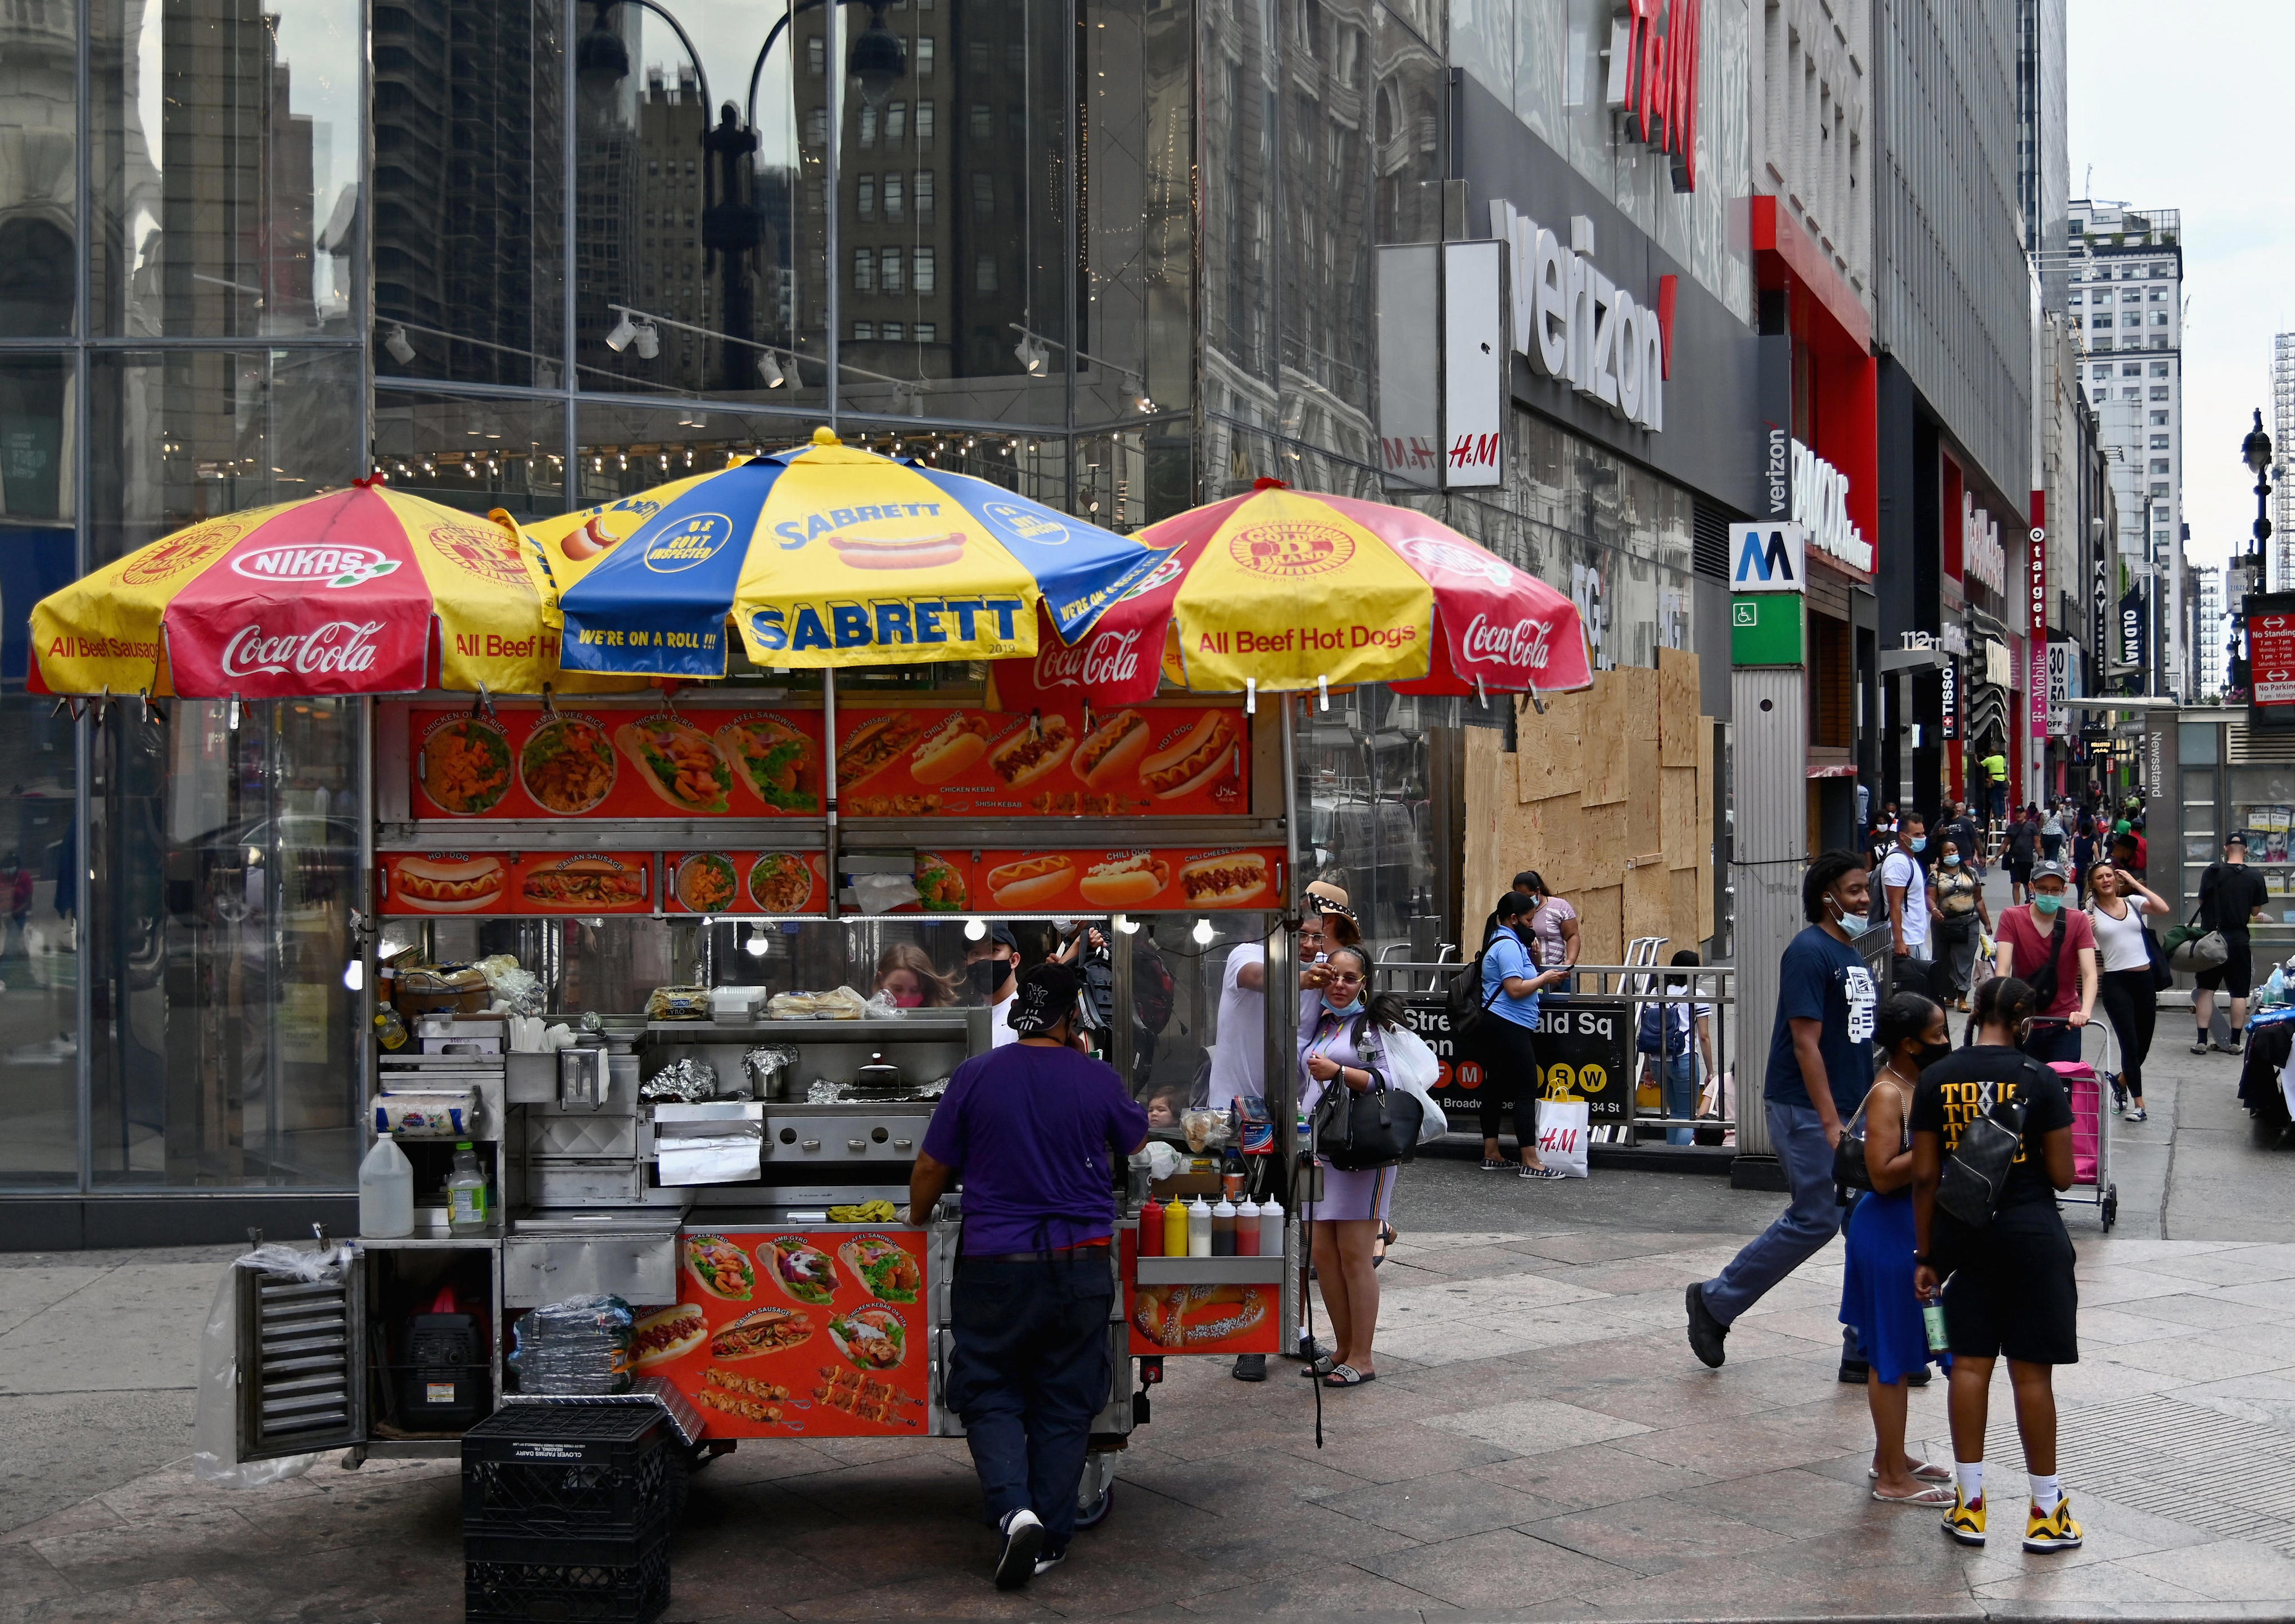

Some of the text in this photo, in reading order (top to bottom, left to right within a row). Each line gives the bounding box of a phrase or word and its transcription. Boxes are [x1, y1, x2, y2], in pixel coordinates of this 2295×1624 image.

[1489, 199, 1663, 433] verizon
[1448, 432, 1499, 469] H&M
[1770, 429, 1785, 513] verizon
[768, 501, 941, 550] SABRETT
[1246, 532, 1334, 543] GOLDEN
[256, 550, 364, 575] NIKAS
[649, 547, 712, 560] INSPECTED
[1259, 550, 1330, 566] BRAND
[2032, 545, 2043, 628] target
[2094, 560, 2106, 615] KAY
[746, 594, 1023, 652] SABRETT
[48, 636, 75, 658] All
[78, 637, 109, 658] Beef
[224, 621, 387, 677] Coca-Cola
[456, 635, 536, 658] All Beef
[579, 629, 625, 647] WE'RE
[629, 631, 649, 647] ON
[653, 632, 663, 648] A
[666, 632, 700, 650] ROLL
[989, 644, 1016, 654] 2019
[1199, 625, 1416, 654] All Beef Hot Dogs
[1463, 613, 1553, 669] Coca-Cola
[1033, 628, 1143, 691] Coca-Cola
[2049, 646, 2064, 676] 30
[422, 712, 510, 736] CHICKEN RICE
[584, 713, 607, 730] RICE
[630, 713, 669, 730] CHICKEN
[719, 711, 801, 735] FALAFEL SANDWICH
[923, 709, 964, 740] CHILI DOG
[1096, 712, 1119, 723] USAGE
[842, 716, 893, 755] ITALIAN SAUSAGE
[985, 717, 1026, 747] CHILI CHEESE
[1157, 722, 1194, 752] HOT DOG
[2151, 731, 2162, 798] Newsstand
[1214, 785, 1238, 798] حلال
[427, 851, 470, 862] HOT DOG
[555, 852, 625, 872] ITALIAN SAUSAGE
[1106, 848, 1151, 862] CHILI DOG
[1184, 853, 1203, 863] CHILI
[1203, 848, 1231, 860] CHEESE
[1402, 1008, 1613, 1041] Stre Sq
[1462, 1067, 1602, 1087] M R W
[1591, 1102, 1620, 1113] 34 St
[1538, 1127, 1578, 1155] H&M
[684, 1233, 729, 1245] CHICKEN GYRO
[769, 1235, 808, 1246] LAMB GYRO
[842, 1233, 900, 1250] FALAFEL SANDWICH
[734, 1306, 792, 1329] ITALIAN SAUSAGE
[847, 1302, 907, 1328] CHICKEN KEBAB ON PITA
